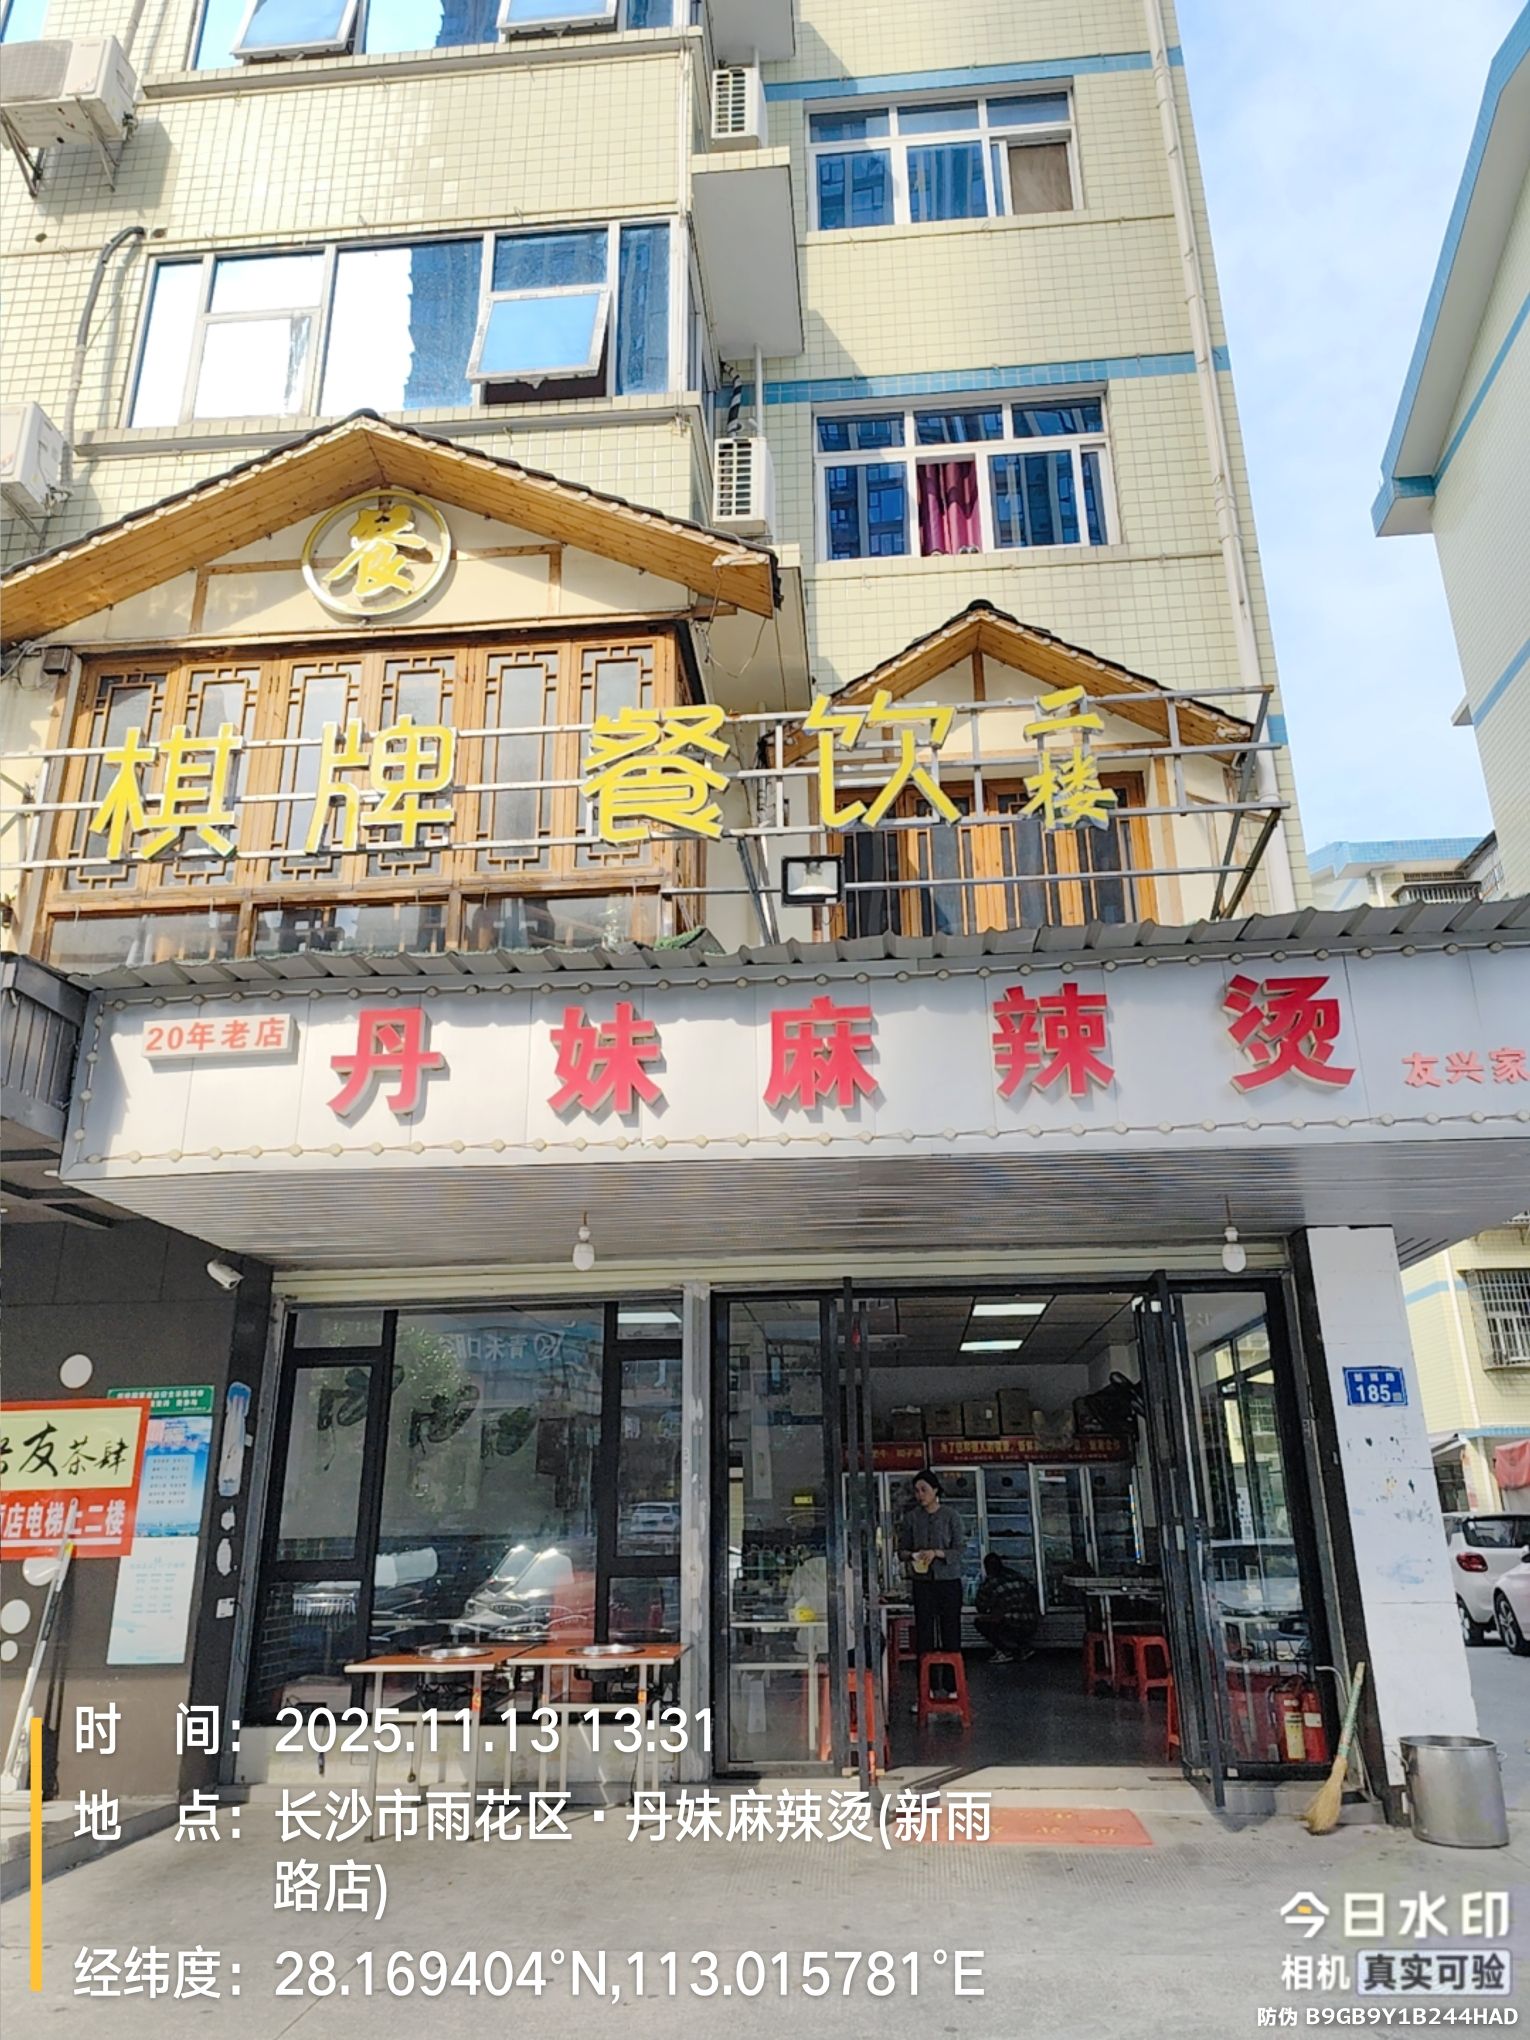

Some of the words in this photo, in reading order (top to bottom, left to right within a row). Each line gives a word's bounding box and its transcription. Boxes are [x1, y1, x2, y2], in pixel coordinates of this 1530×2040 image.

[1019, 685, 1117, 830] 二楼
[146, 1015, 287, 1052] 20年老店
[326, 974, 1356, 1117] 丹妹麻辣烫
[1401, 1047, 1530, 1088] 友兴家
[0, 1499, 126, 1539] 店电梯上二楼
